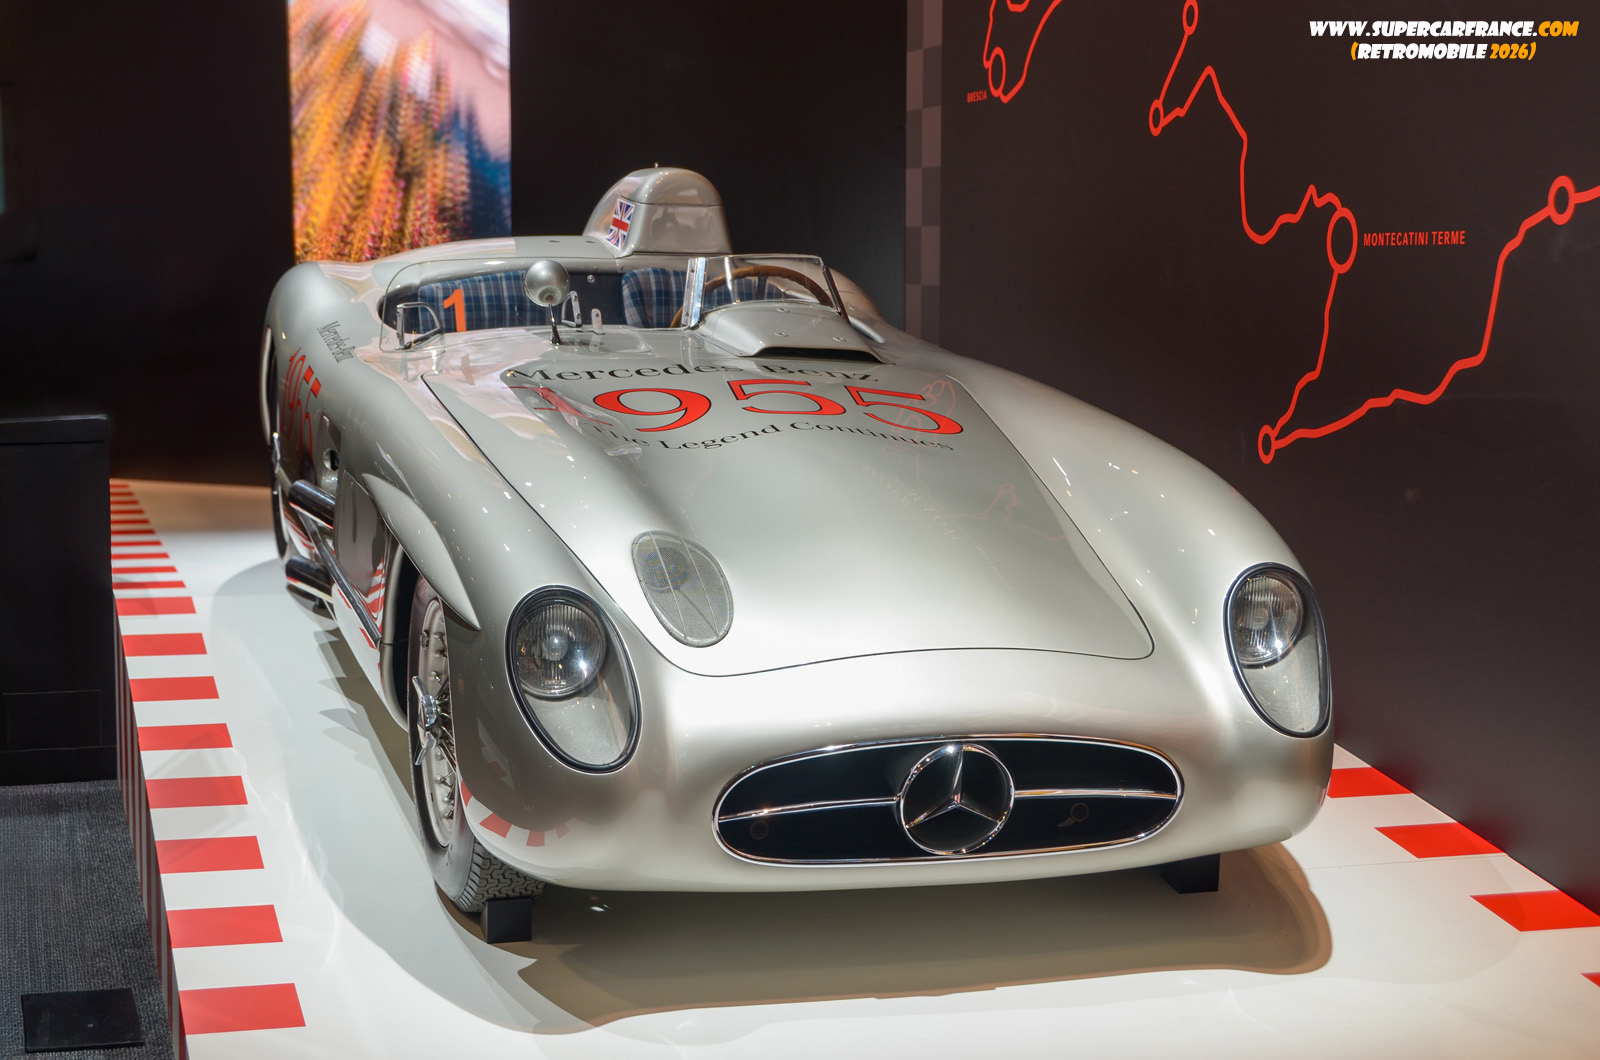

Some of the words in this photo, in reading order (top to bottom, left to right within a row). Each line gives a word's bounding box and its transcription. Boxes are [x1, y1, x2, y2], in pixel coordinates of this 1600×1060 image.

[967, 90, 987, 103] BRESCIA
[1363, 231, 1429, 246] MONTECATINI
[1432, 230, 1466, 245] TERME
[507, 363, 744, 382] Mercedes
[761, 365, 879, 382] Benz
[504, 378, 964, 435] 1955
[658, 424, 782, 450] Legend
[790, 421, 954, 451] Continues
